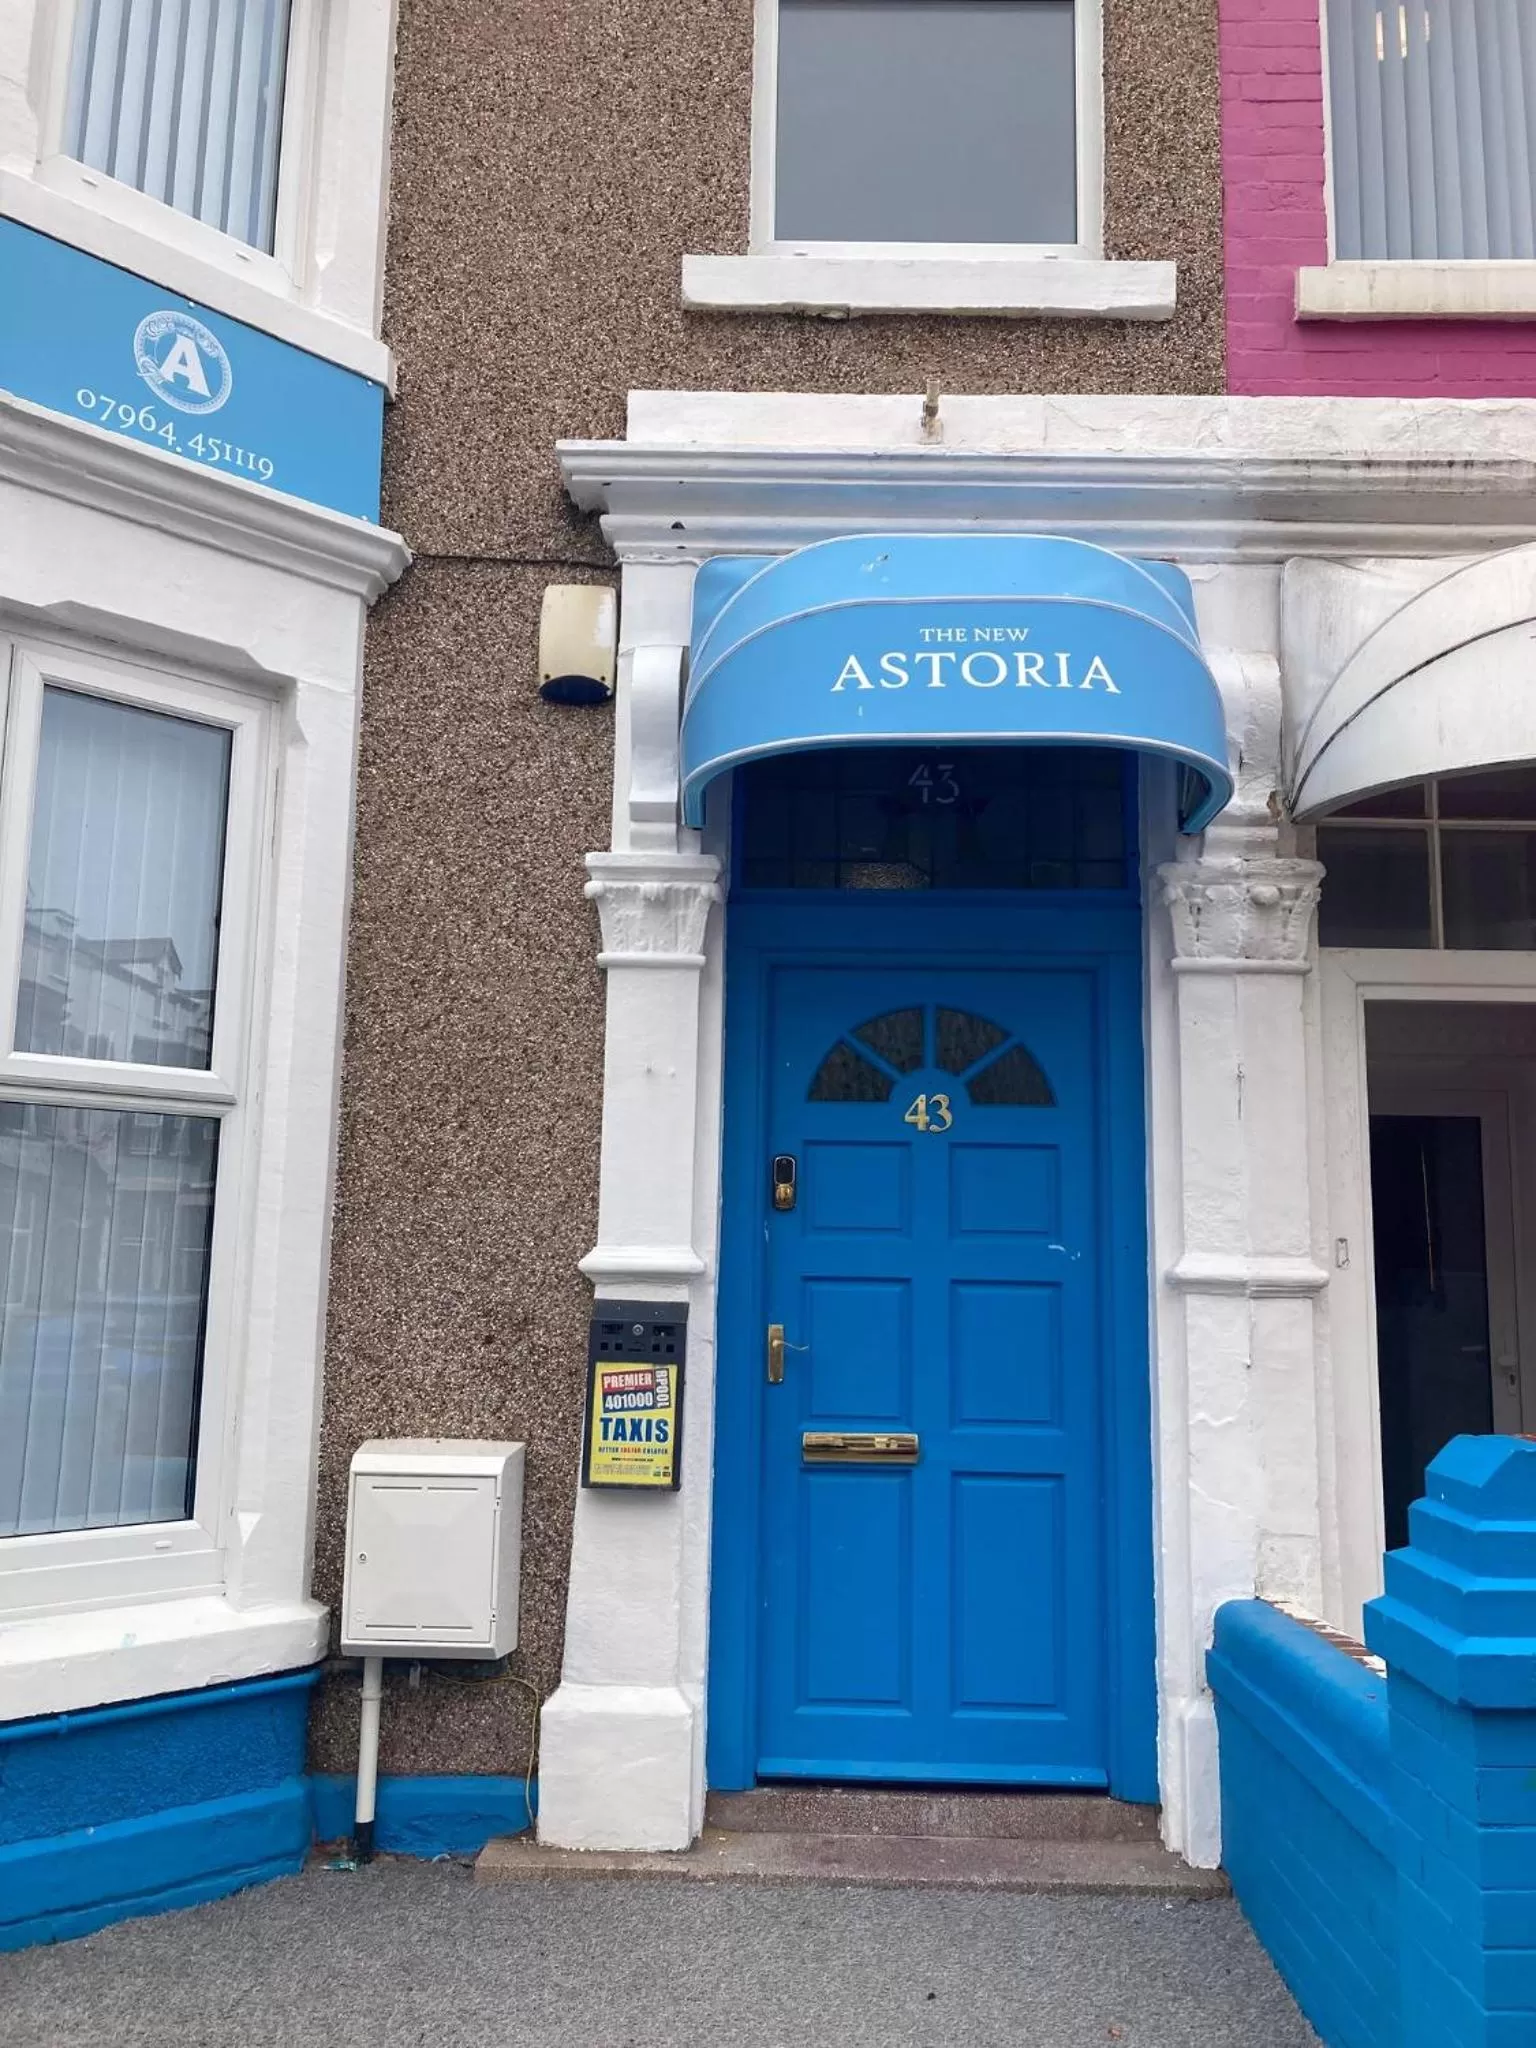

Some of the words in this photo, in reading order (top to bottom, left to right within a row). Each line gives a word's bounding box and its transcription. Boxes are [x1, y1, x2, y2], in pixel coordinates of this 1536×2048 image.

[919, 627, 968, 643] THE
[973, 627, 1029, 643] NEW
[829, 651, 1122, 695] ASTORIA
[907, 763, 960, 804] 43
[903, 1093, 953, 1132] 43
[603, 1373, 652, 1388] PREMIER
[605, 1392, 653, 1409] 401000
[600, 1417, 669, 1443] TAXIS
